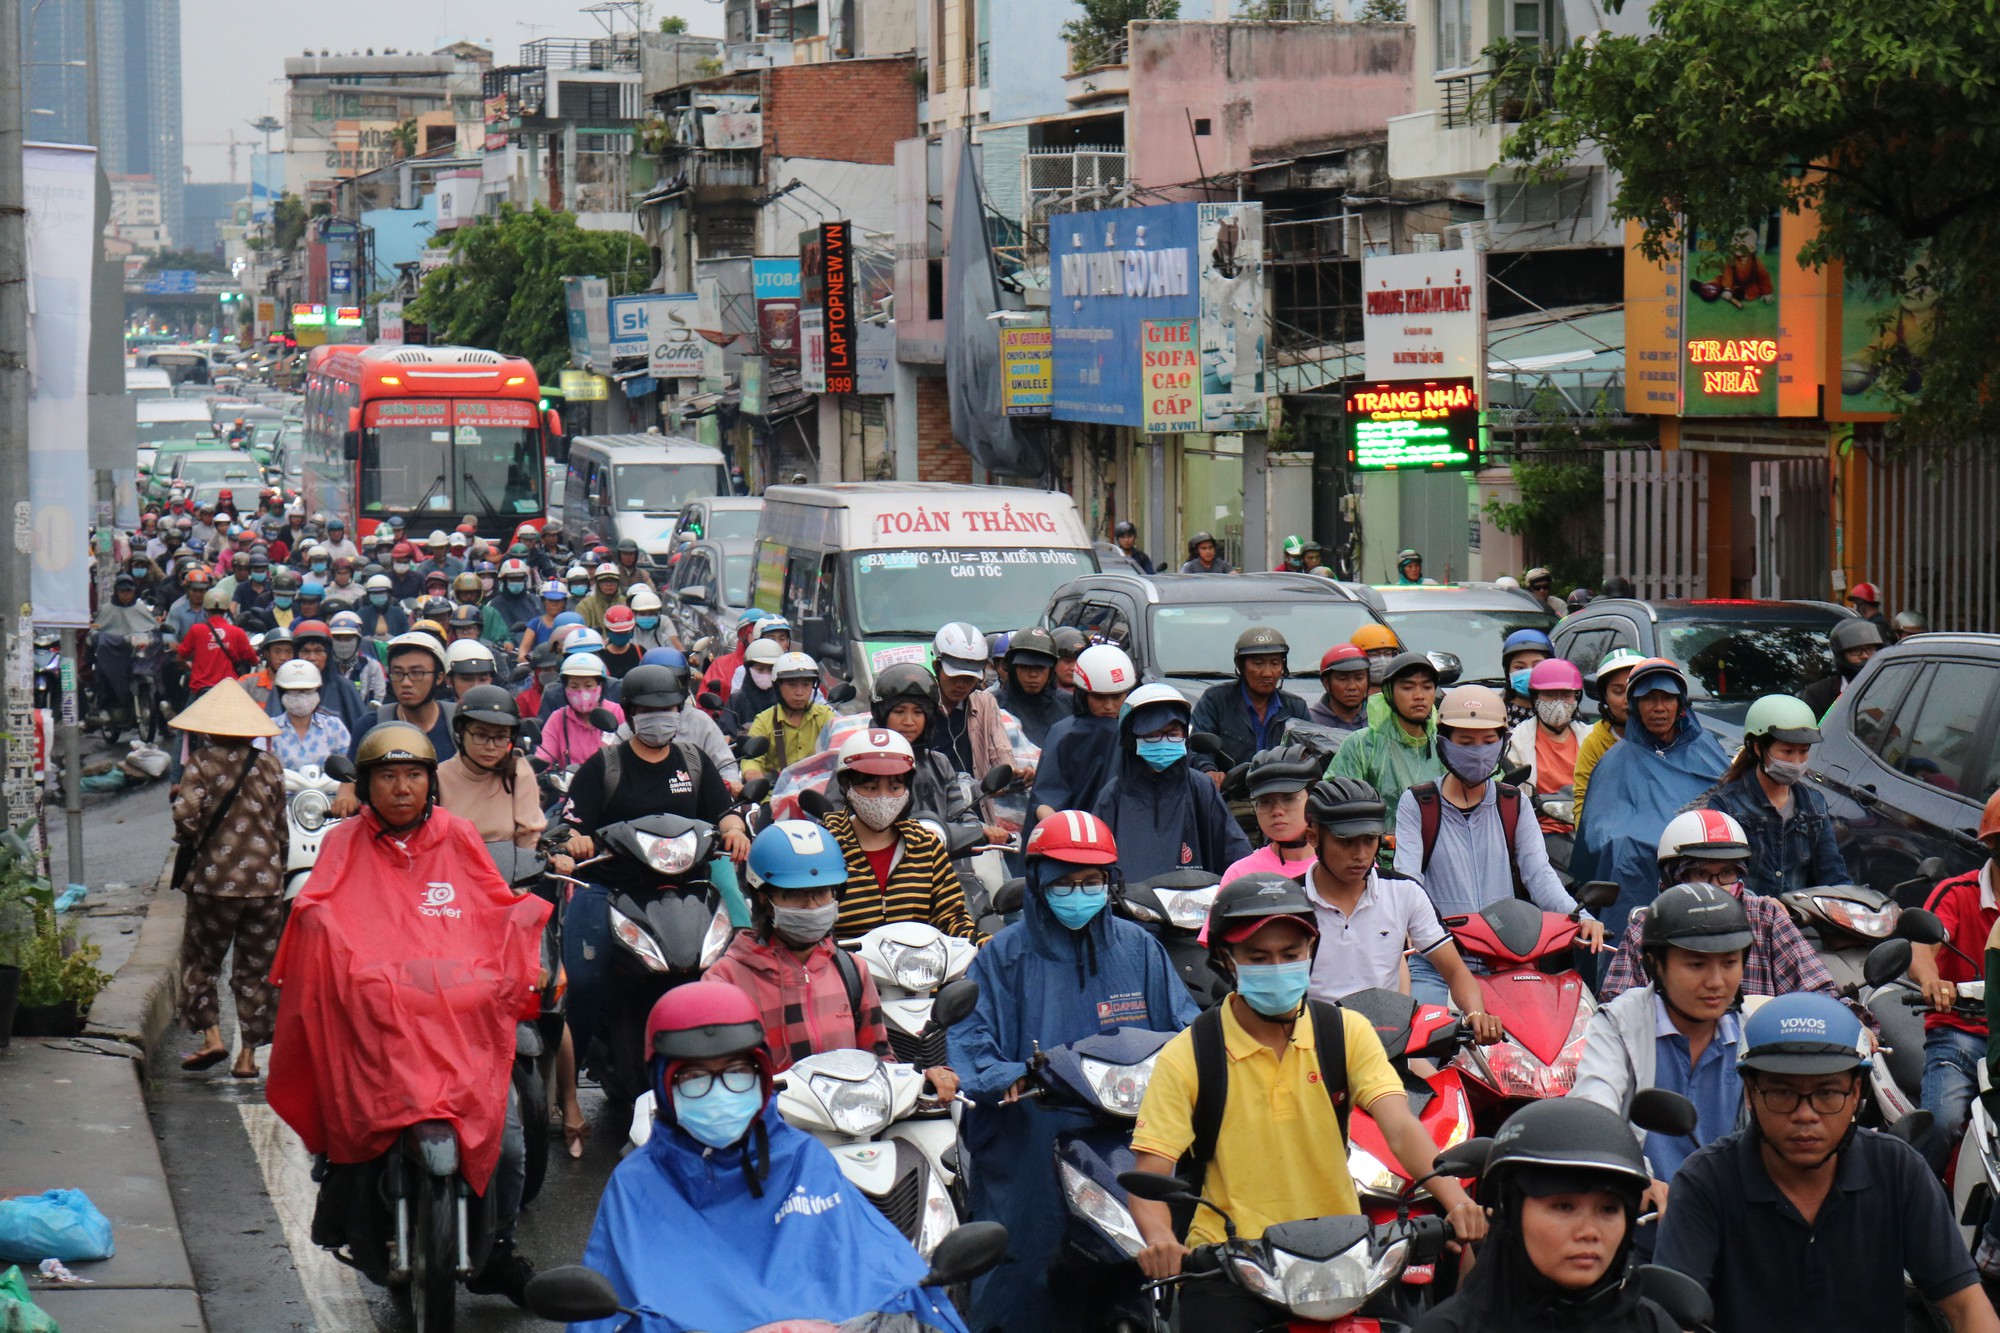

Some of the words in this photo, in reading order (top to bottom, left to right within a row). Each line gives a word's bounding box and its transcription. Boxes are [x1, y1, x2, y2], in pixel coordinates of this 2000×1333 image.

[826, 224, 848, 367] LAPTOPNEW.VN
[1147, 320, 1192, 343] GHẾ
[1145, 350, 1197, 367] SOFA
[1688, 339, 1778, 365] TRANG
[1011, 365, 1040, 375] GUITAR
[826, 376, 852, 393] 399
[1012, 378, 1048, 389] UKULELE
[1152, 372, 1192, 390] CAO
[1152, 394, 1192, 415] CẤP
[1354, 390, 1420, 412] TRANG
[416, 404, 446, 416] TRANG
[457, 404, 488, 416] FUTA
[1170, 421, 1197, 431] XVNT
[876, 505, 951, 534] TOÀN
[962, 502, 1056, 533] THẮNG
[932, 549, 961, 564] TÀU
[1041, 549, 1077, 565] ĐÔNG
[951, 565, 975, 577] CAO
[976, 561, 1003, 577] TỐC
[1780, 1017, 1826, 1029] VOVOS
